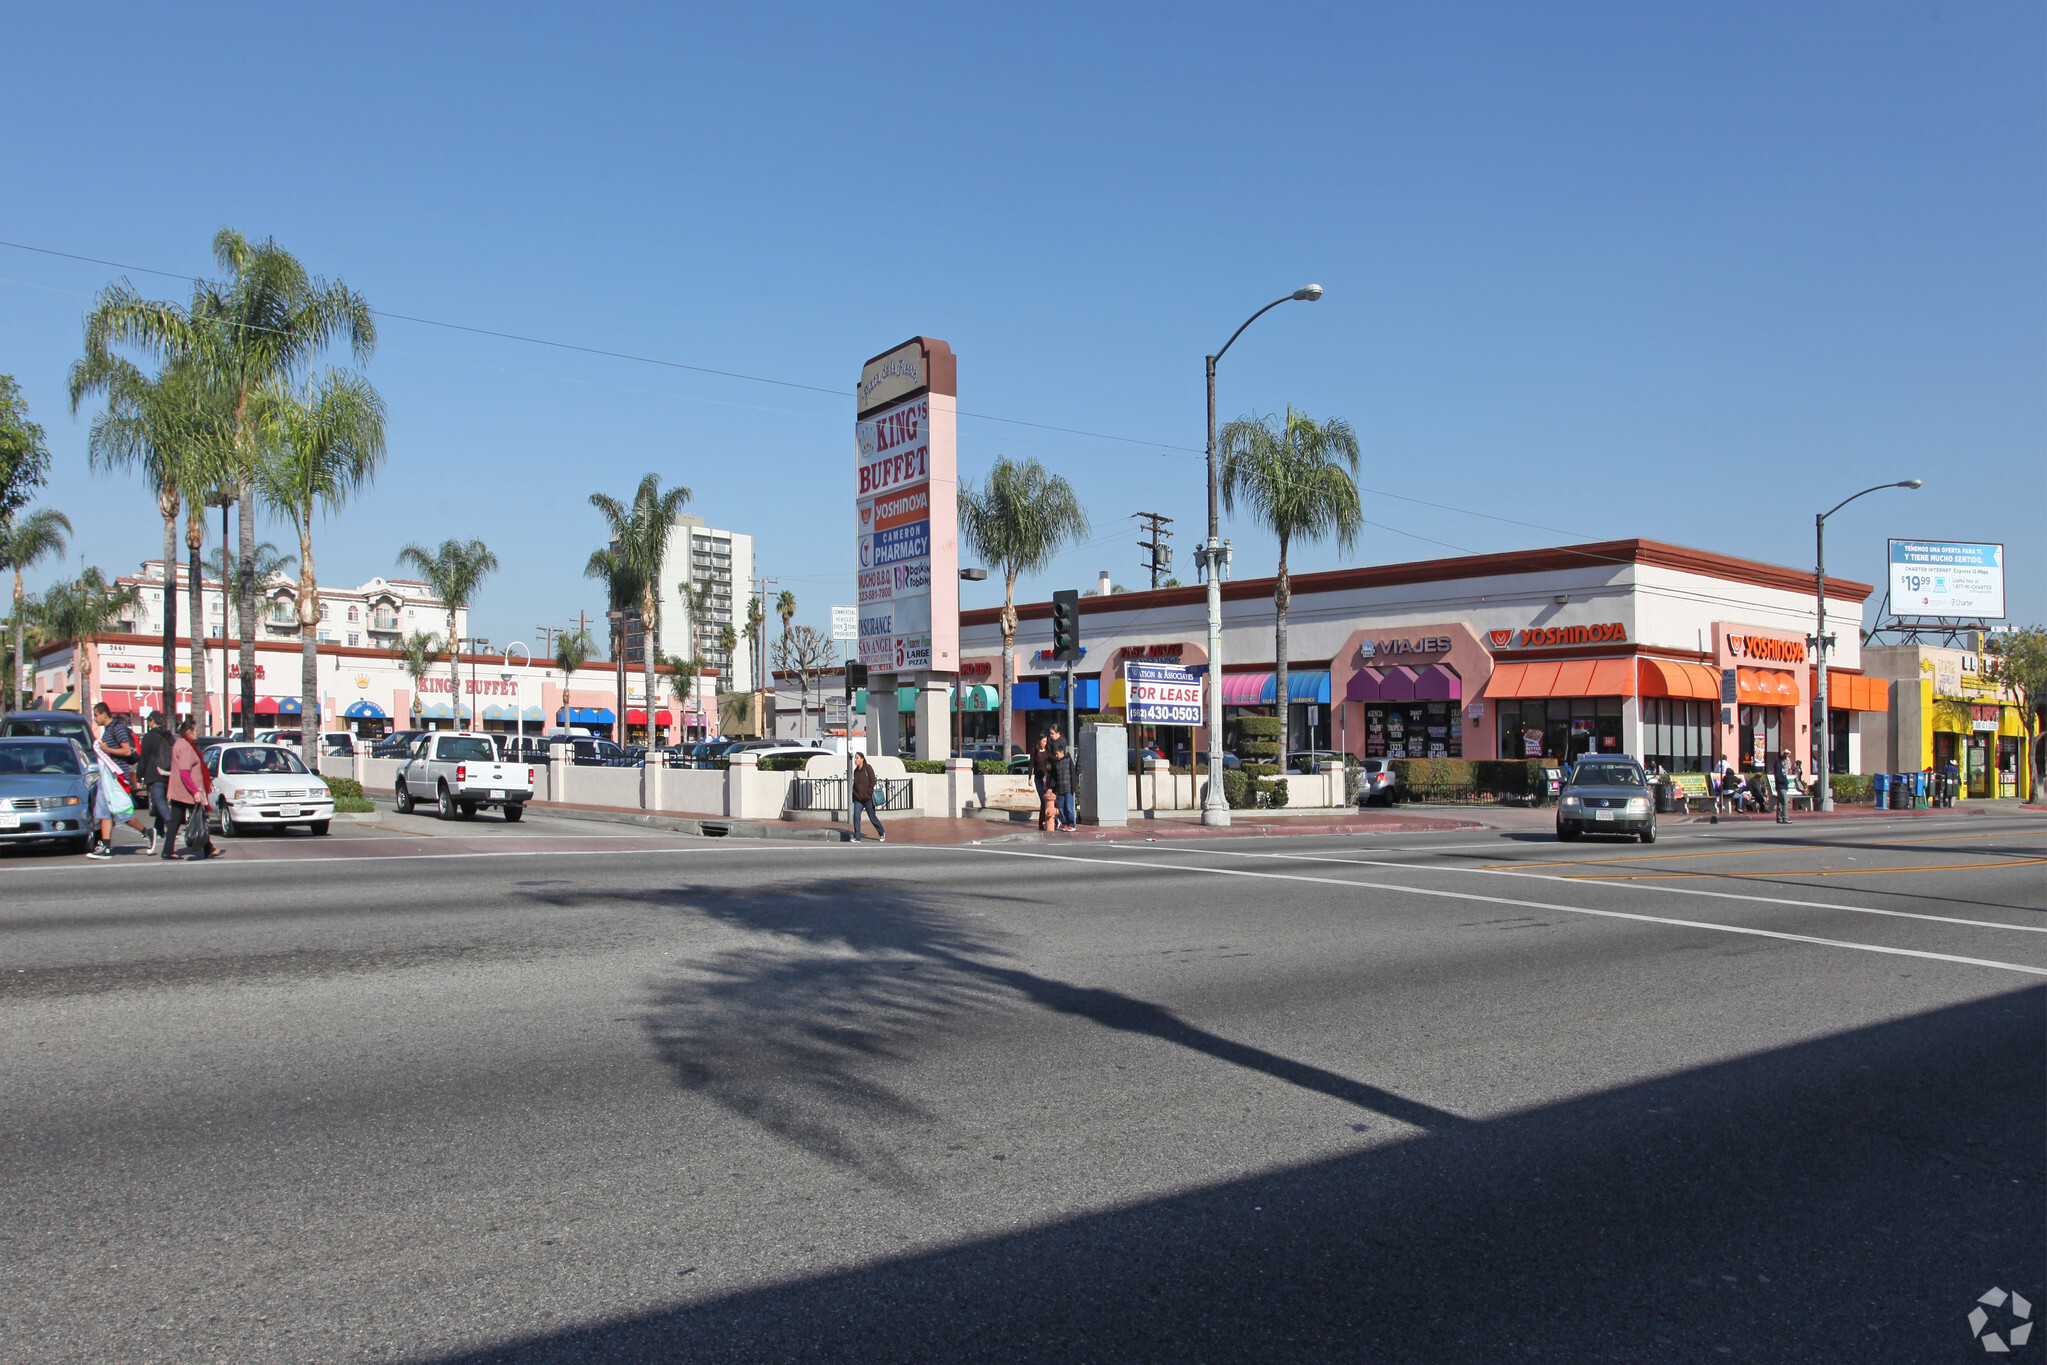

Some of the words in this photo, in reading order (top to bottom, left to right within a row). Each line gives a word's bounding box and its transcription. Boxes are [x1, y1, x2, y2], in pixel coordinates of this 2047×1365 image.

[876, 401, 928, 452] KING'S
[859, 445, 928, 494] BUFFET
[882, 525, 921, 543] CAMERON
[875, 536, 928, 564] PHARMACY
[1904, 553, 1910, 561] Y
[1911, 554, 1930, 562] TIENE
[1930, 554, 1954, 562] MUCHO
[858, 586, 892, 602] 323-581-7800
[843, 622, 848, 632] 3
[1520, 622, 1627, 646] YOSHINOYA
[858, 640, 872, 655] SAN
[871, 638, 893, 654] ANGEL
[906, 648, 930, 659] LARGE
[1120, 645, 1146, 658] FAST
[1148, 643, 1184, 657] QUOTE
[1380, 636, 1452, 655] VIAJES
[1744, 635, 1805, 663] YOSHINOYA
[908, 658, 928, 666] PIZZA
[974, 662, 992, 675] BBQ
[1157, 671, 1163, 679] &
[465, 679, 518, 695] BUFFET
[1130, 686, 1156, 700] FOR
[1160, 688, 1199, 702] LEASE
[1130, 708, 1147, 720] (562)
[1147, 705, 1199, 721] 430-0503
